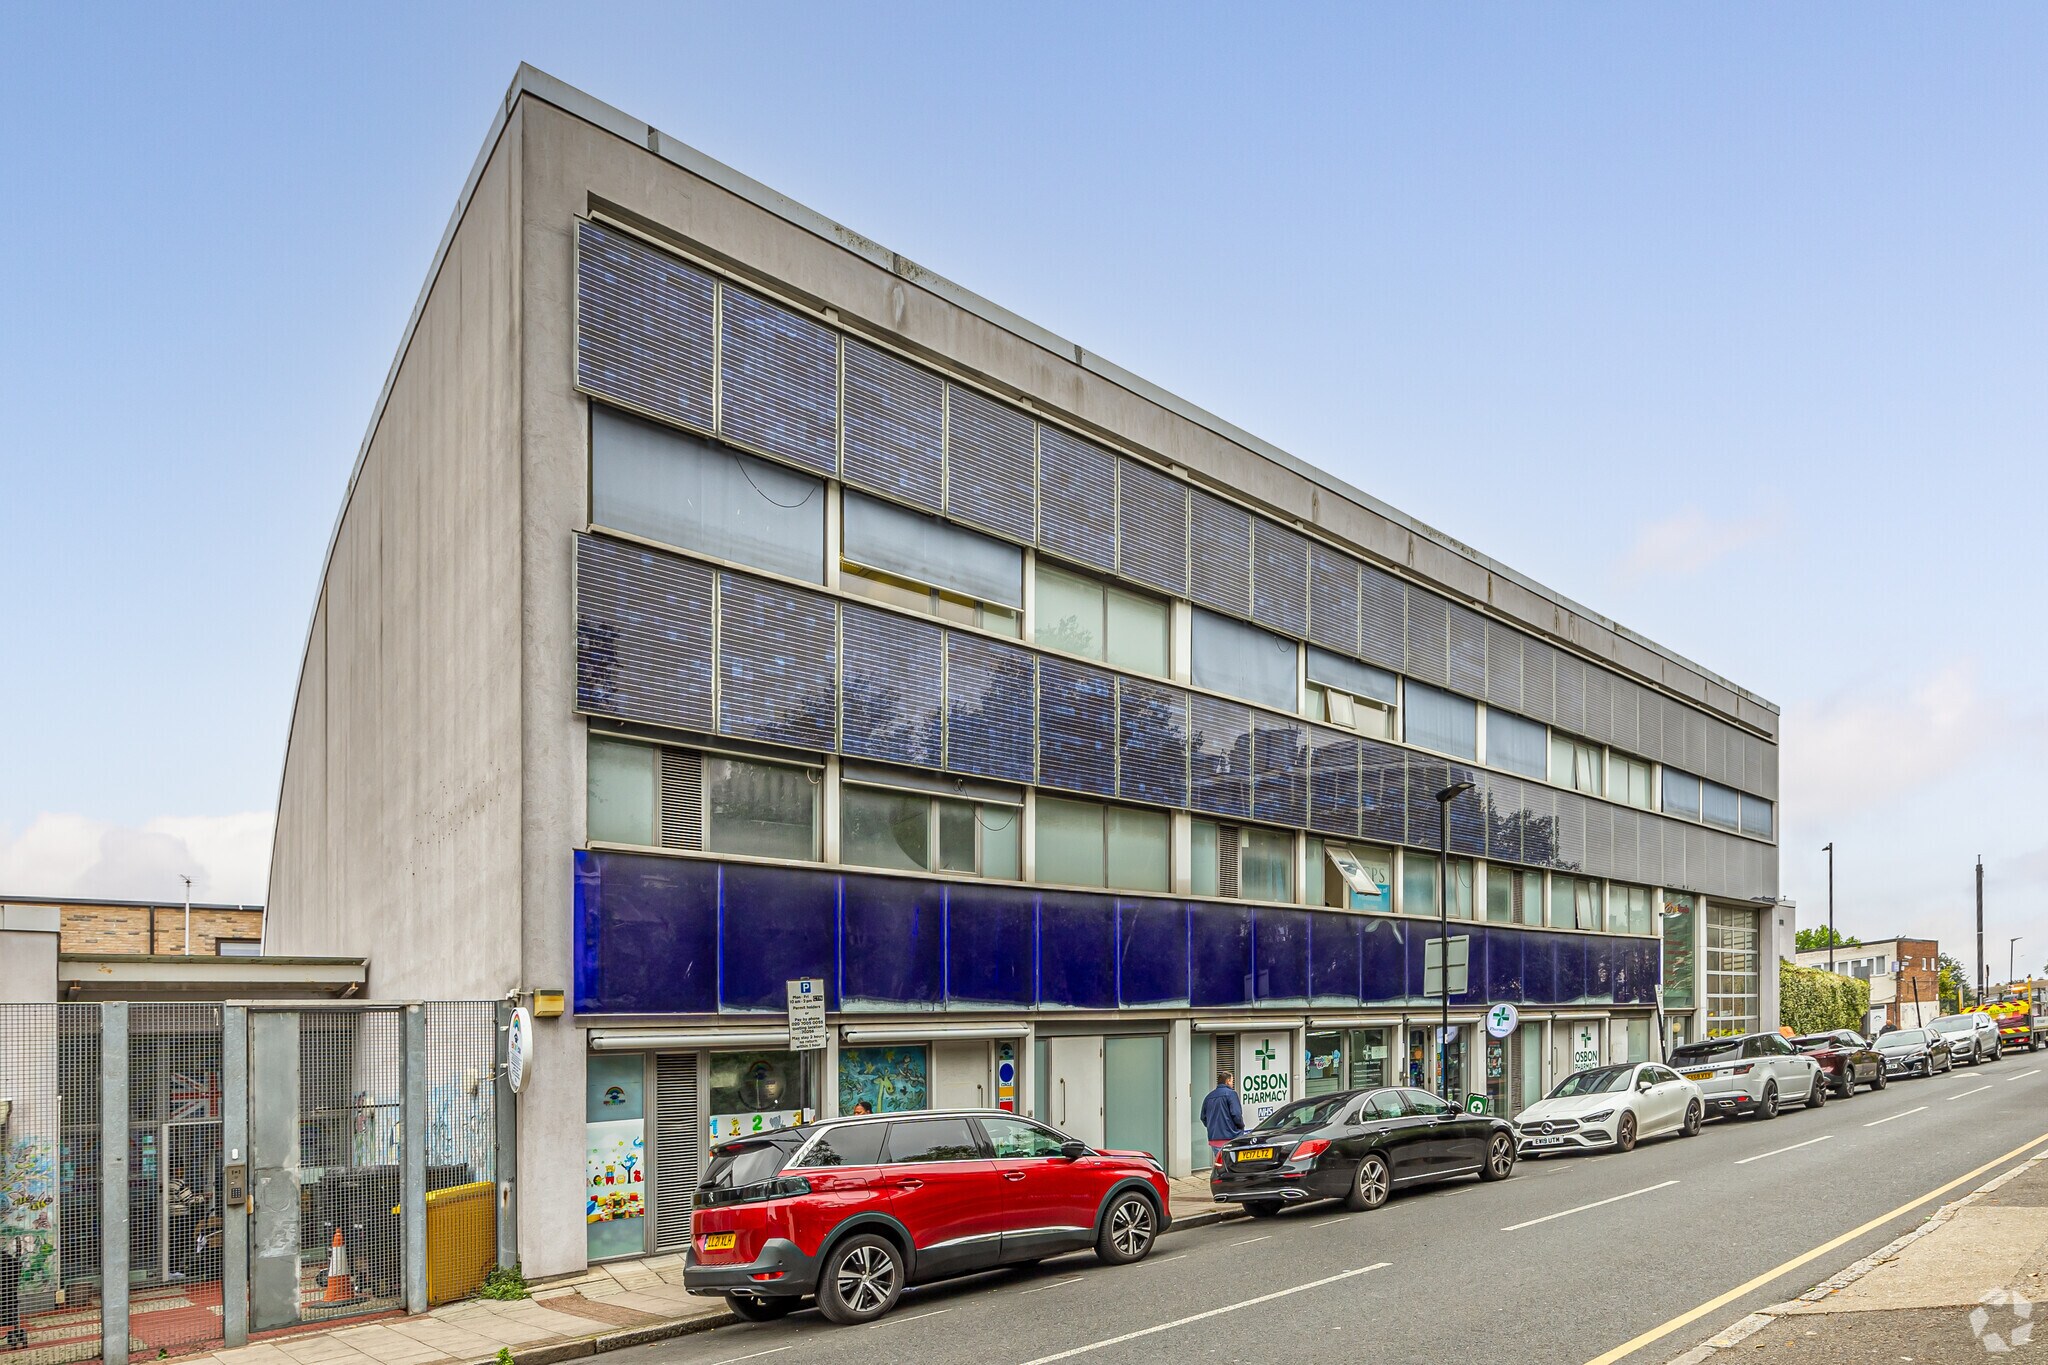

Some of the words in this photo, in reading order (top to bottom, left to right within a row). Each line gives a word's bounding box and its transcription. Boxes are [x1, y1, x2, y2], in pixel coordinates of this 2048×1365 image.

[1575, 1050, 1597, 1062] OSBON
[1243, 1073, 1287, 1091] OSBON
[1243, 1090, 1287, 1104] PHARMACY
[1259, 1107, 1273, 1117] NHS
[752, 1115, 762, 1130] 2
